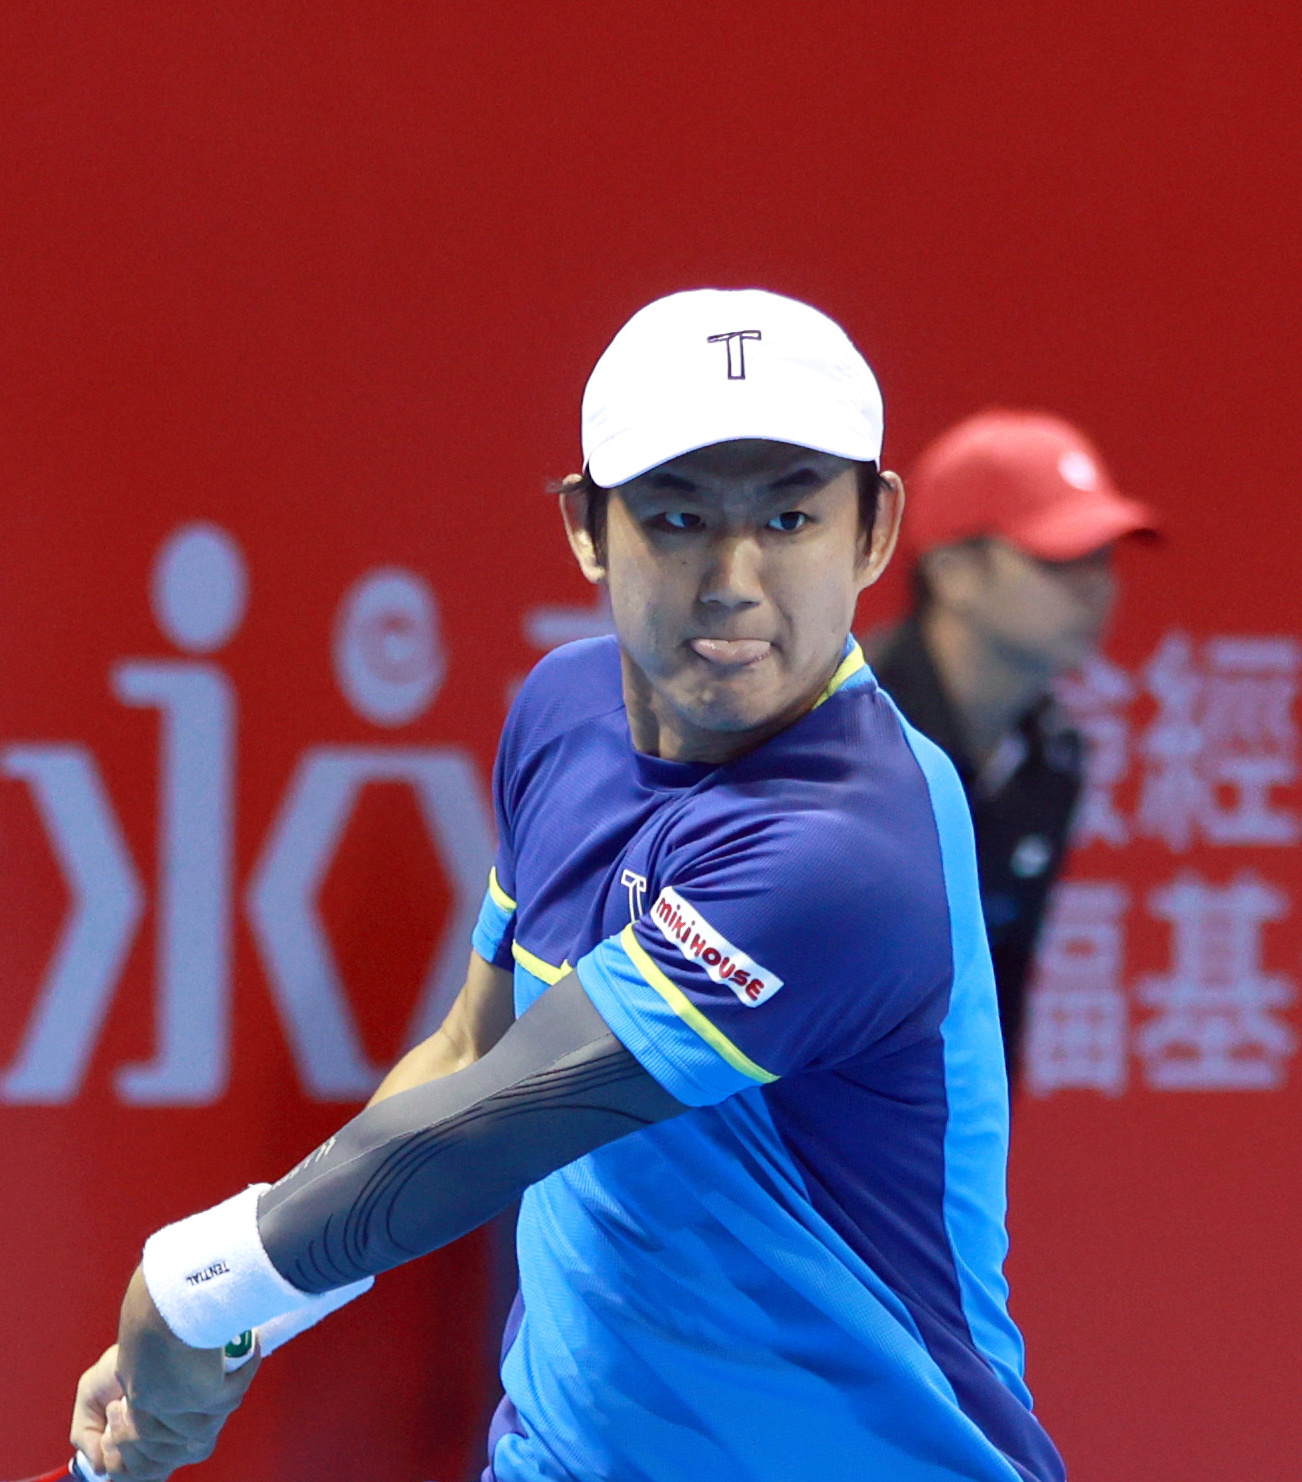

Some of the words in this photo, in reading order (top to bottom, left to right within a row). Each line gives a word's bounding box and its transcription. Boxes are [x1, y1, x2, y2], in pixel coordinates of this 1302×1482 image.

[707, 329, 761, 380] T
[690, 933, 765, 1001] HOUSE
[186, 1261, 230, 1286] TENTIAL
